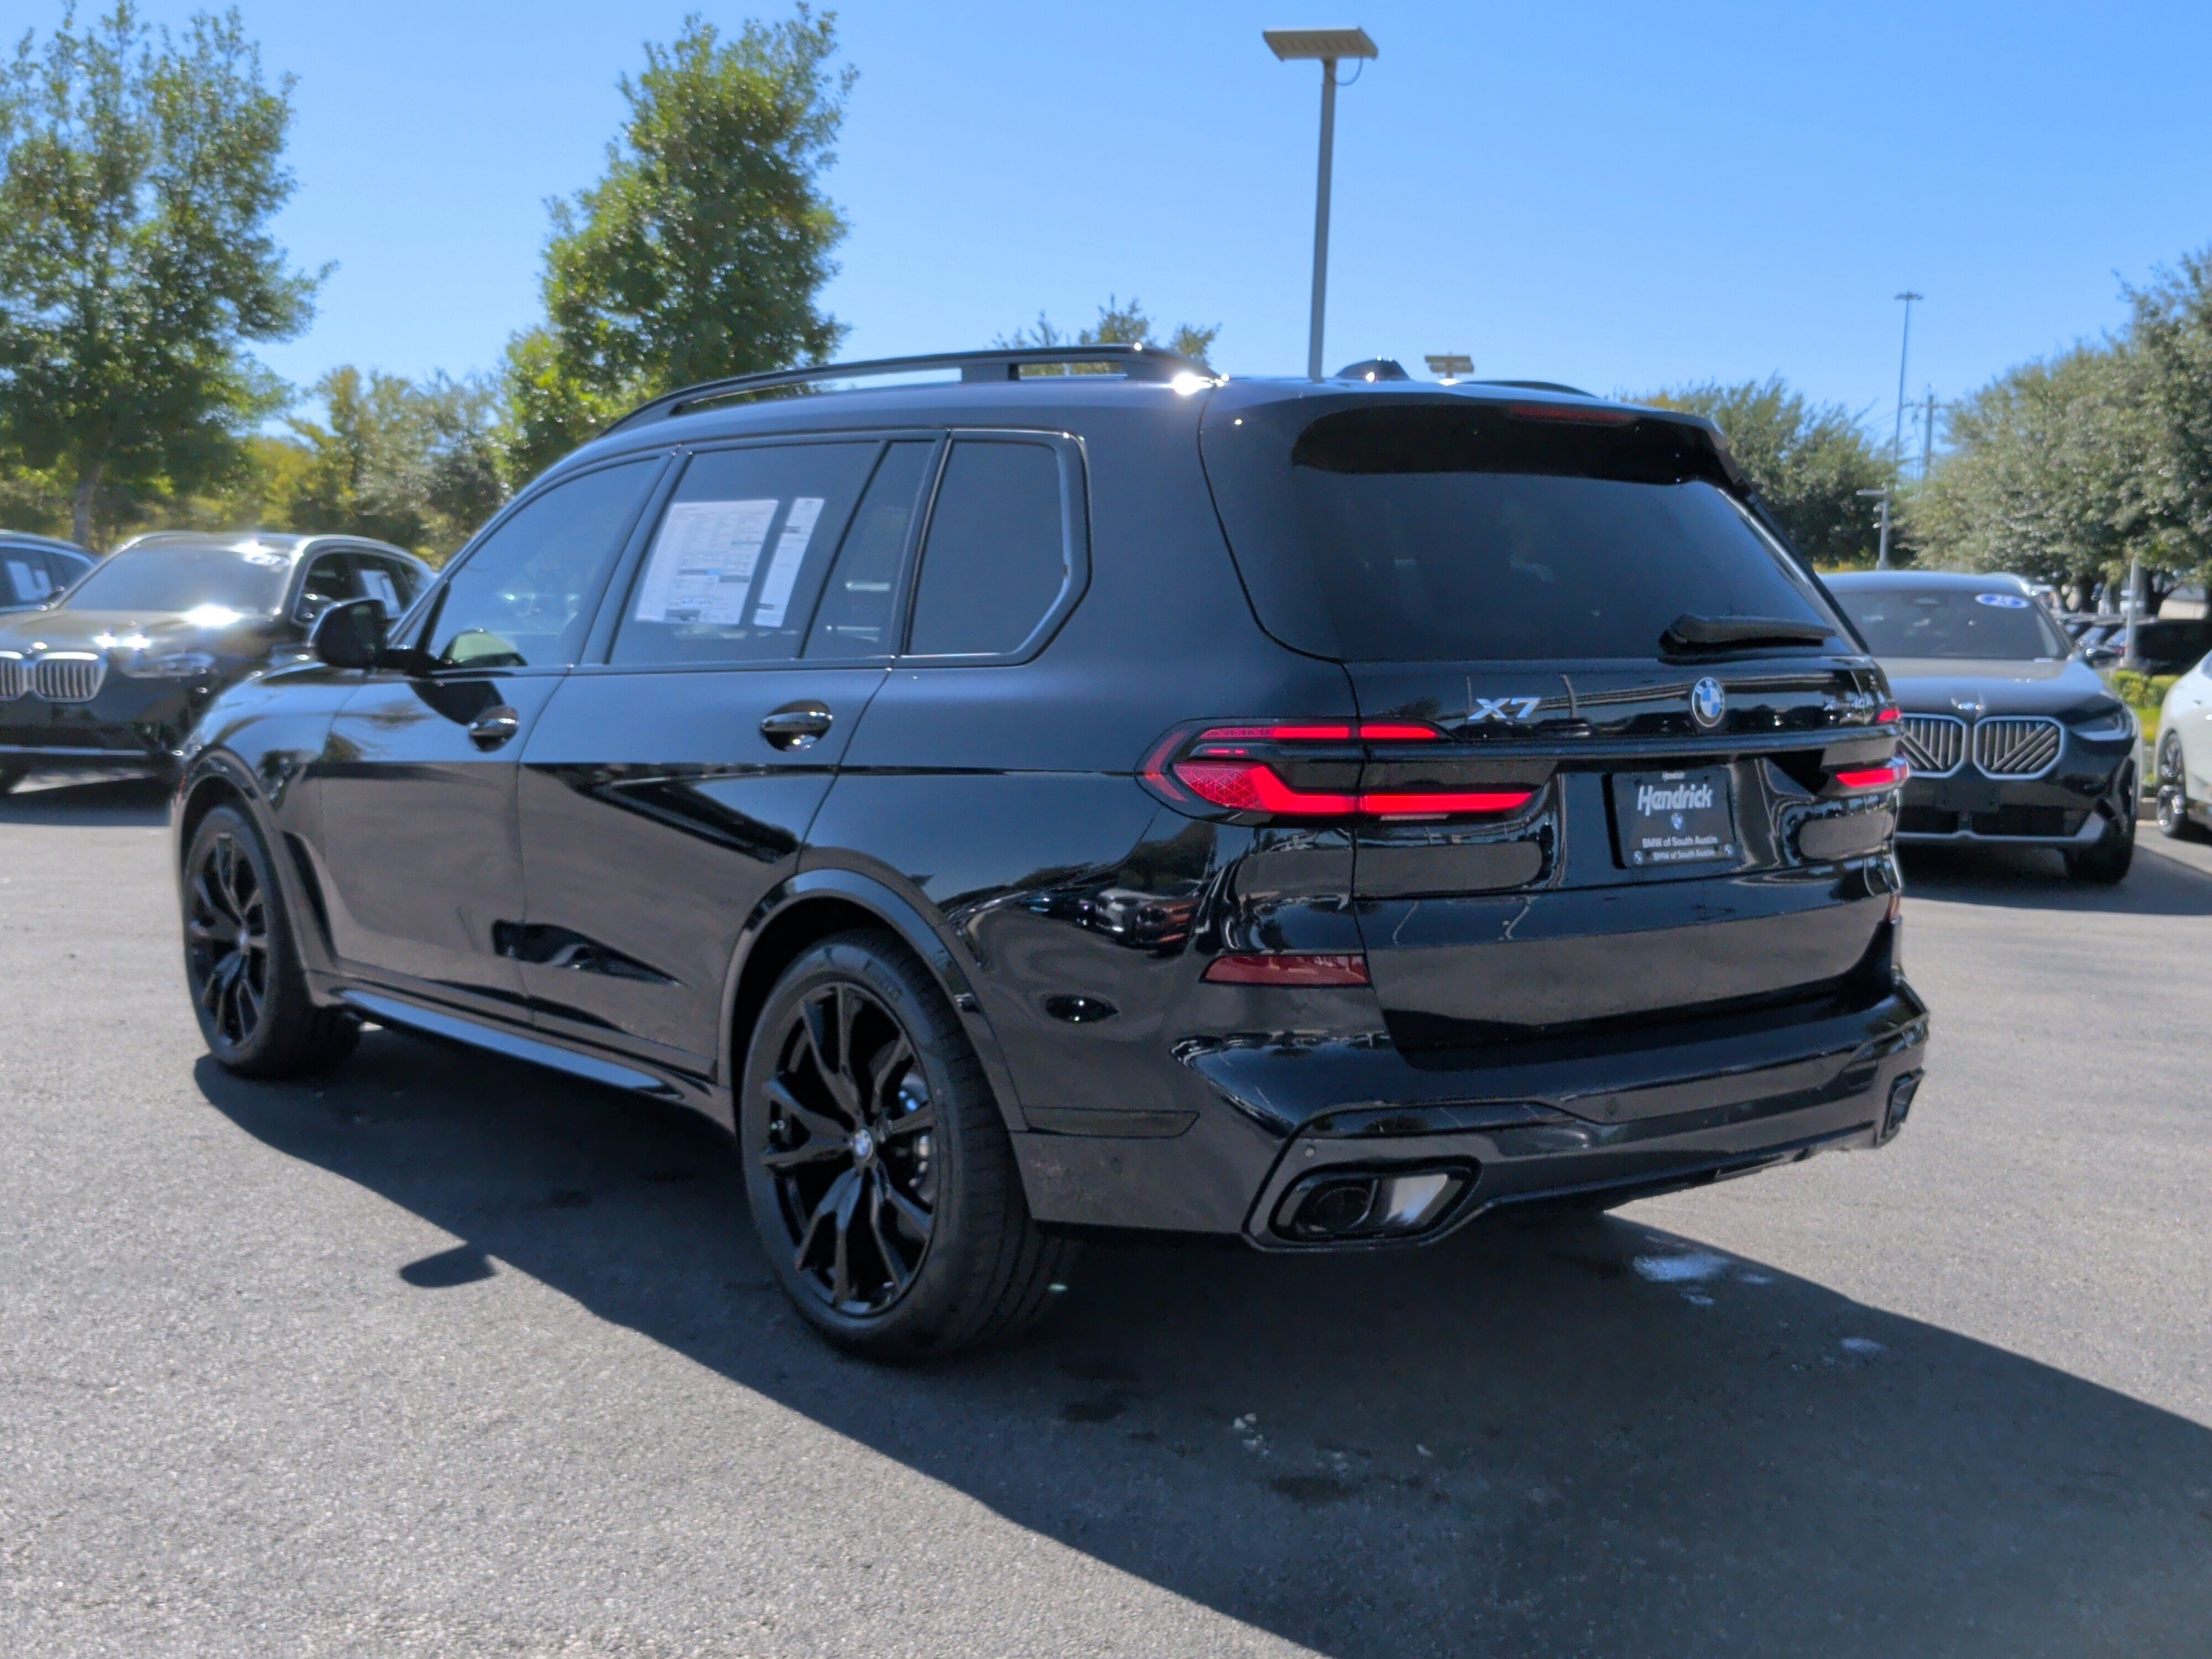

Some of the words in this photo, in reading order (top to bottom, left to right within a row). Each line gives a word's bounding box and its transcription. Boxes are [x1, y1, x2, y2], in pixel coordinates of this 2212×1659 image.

[1468, 697, 1541, 719] X7
[1637, 784, 1713, 817] Hendrick
[1642, 837, 1662, 848] BMW
[1663, 836, 1671, 847] of
[1671, 836, 1694, 847] South
[1694, 834, 1718, 845] Austin
[1653, 852, 1670, 861] BMW
[1670, 851, 1676, 859] of
[1677, 849, 1695, 858] South
